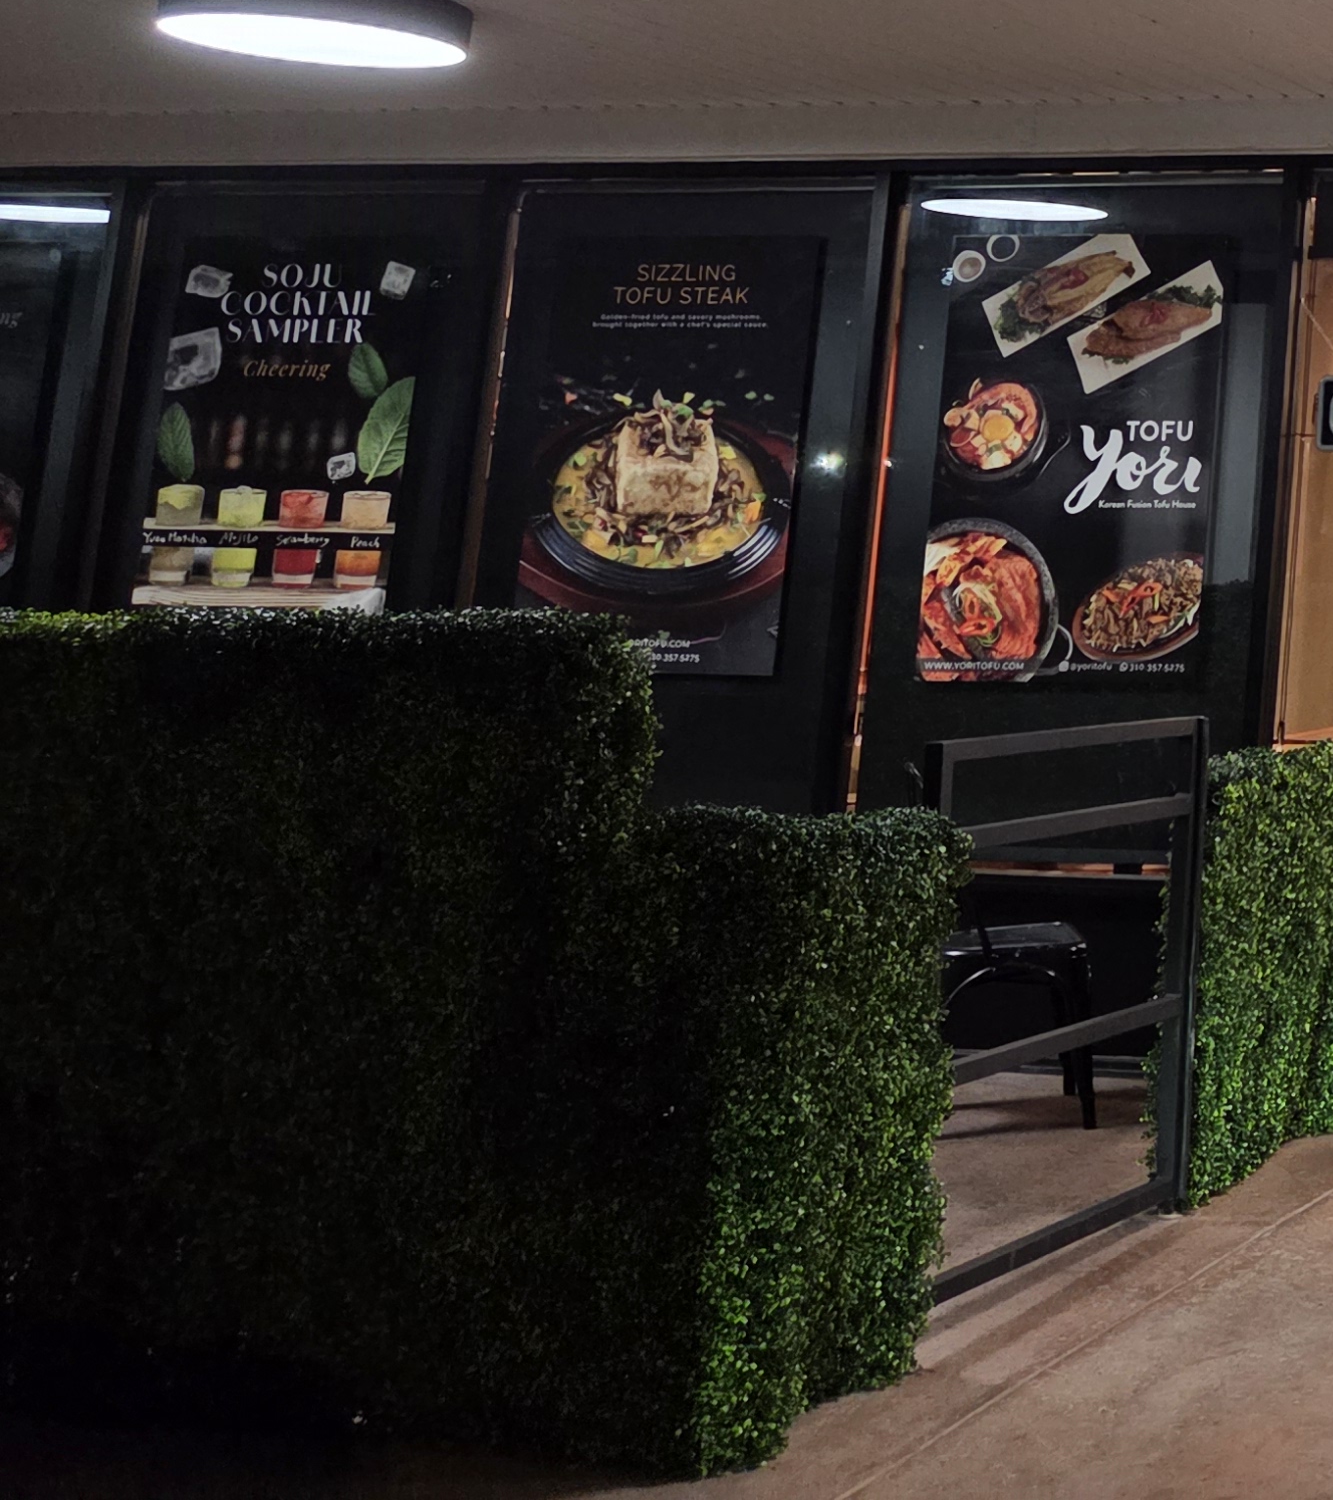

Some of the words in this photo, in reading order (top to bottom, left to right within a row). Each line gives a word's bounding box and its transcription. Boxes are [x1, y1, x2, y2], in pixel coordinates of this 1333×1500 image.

[261, 263, 343, 288] SOJU
[637, 264, 736, 282] SIZZLING
[221, 290, 377, 316] COCKTAIL
[613, 286, 672, 305] TOFU
[679, 286, 750, 305] STEAK
[226, 317, 363, 344] SAMPLER
[243, 359, 331, 381] Cheering
[1126, 420, 1194, 442] TOFU
